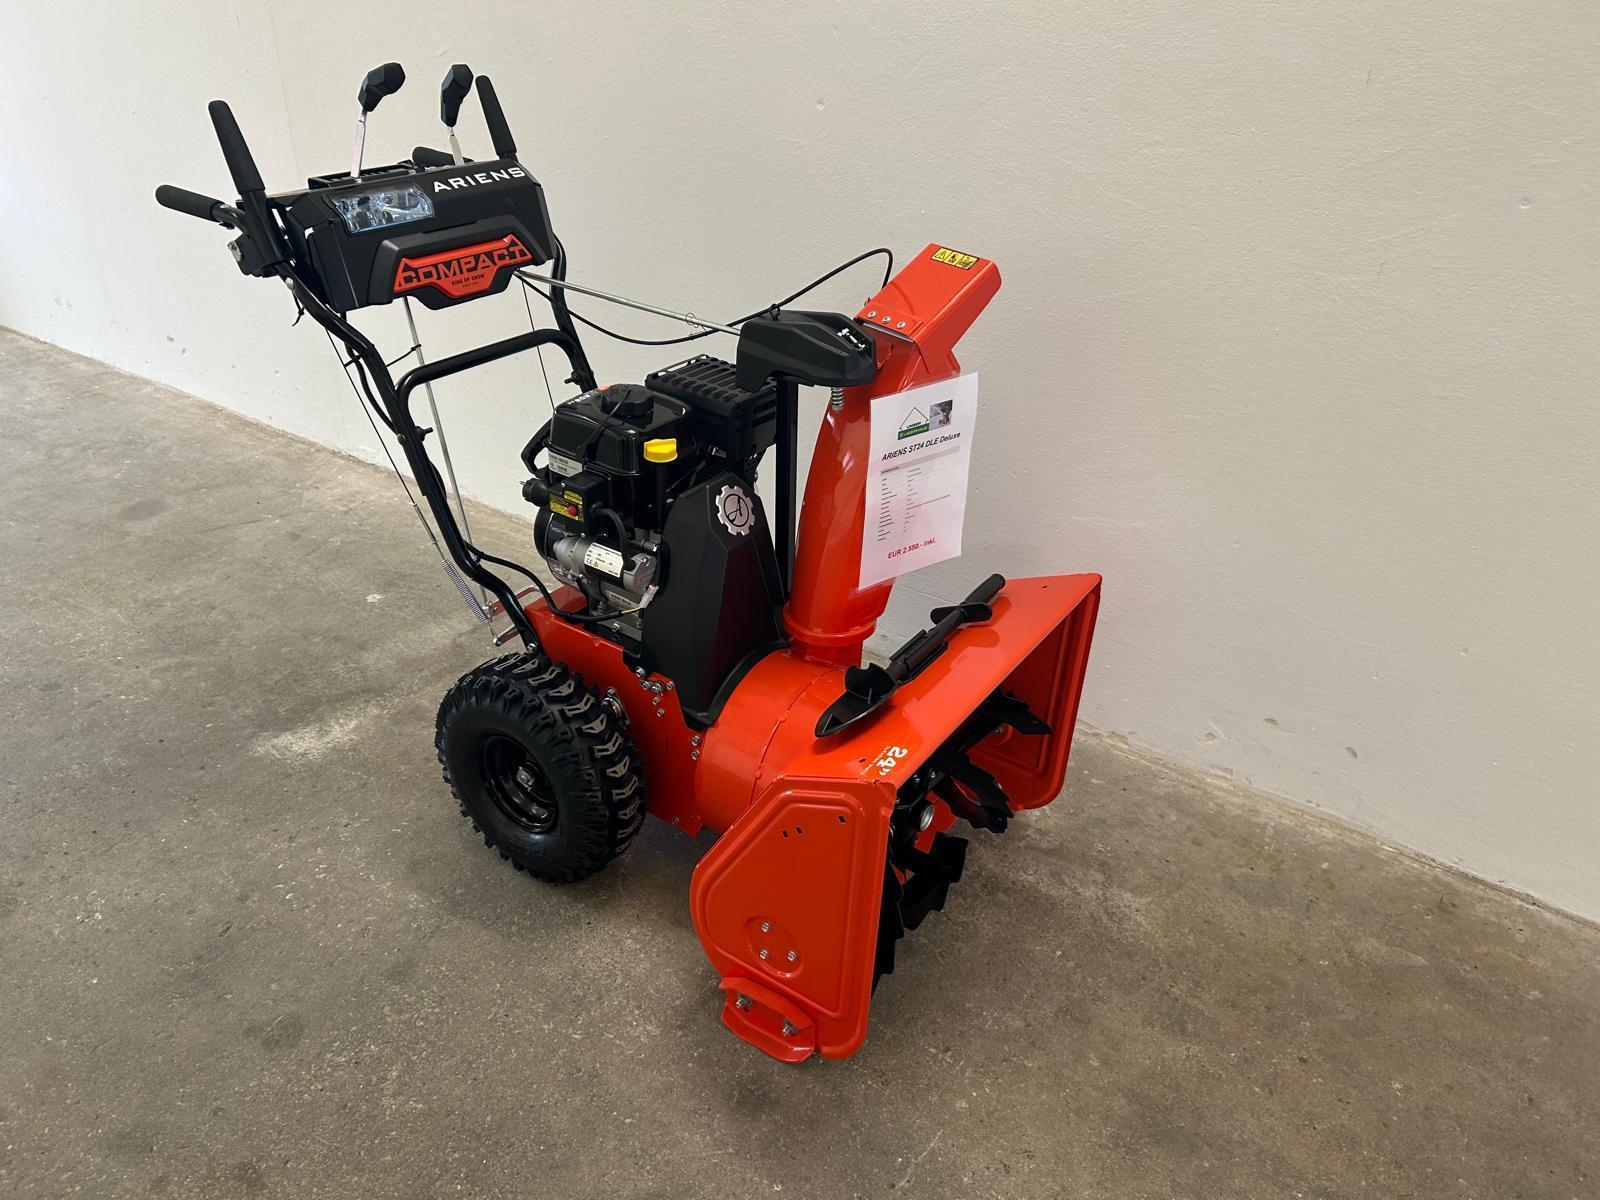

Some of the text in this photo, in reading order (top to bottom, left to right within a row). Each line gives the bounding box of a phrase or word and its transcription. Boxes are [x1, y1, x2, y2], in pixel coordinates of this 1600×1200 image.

[433, 167, 526, 193] ARIENS
[398, 245, 524, 285] COMPACT
[881, 447, 908, 462] ARIENS
[908, 441, 925, 453] ST24
[925, 437, 940, 448] DLE
[939, 432, 961, 443] Deluxe
[887, 548, 902, 559] EUR
